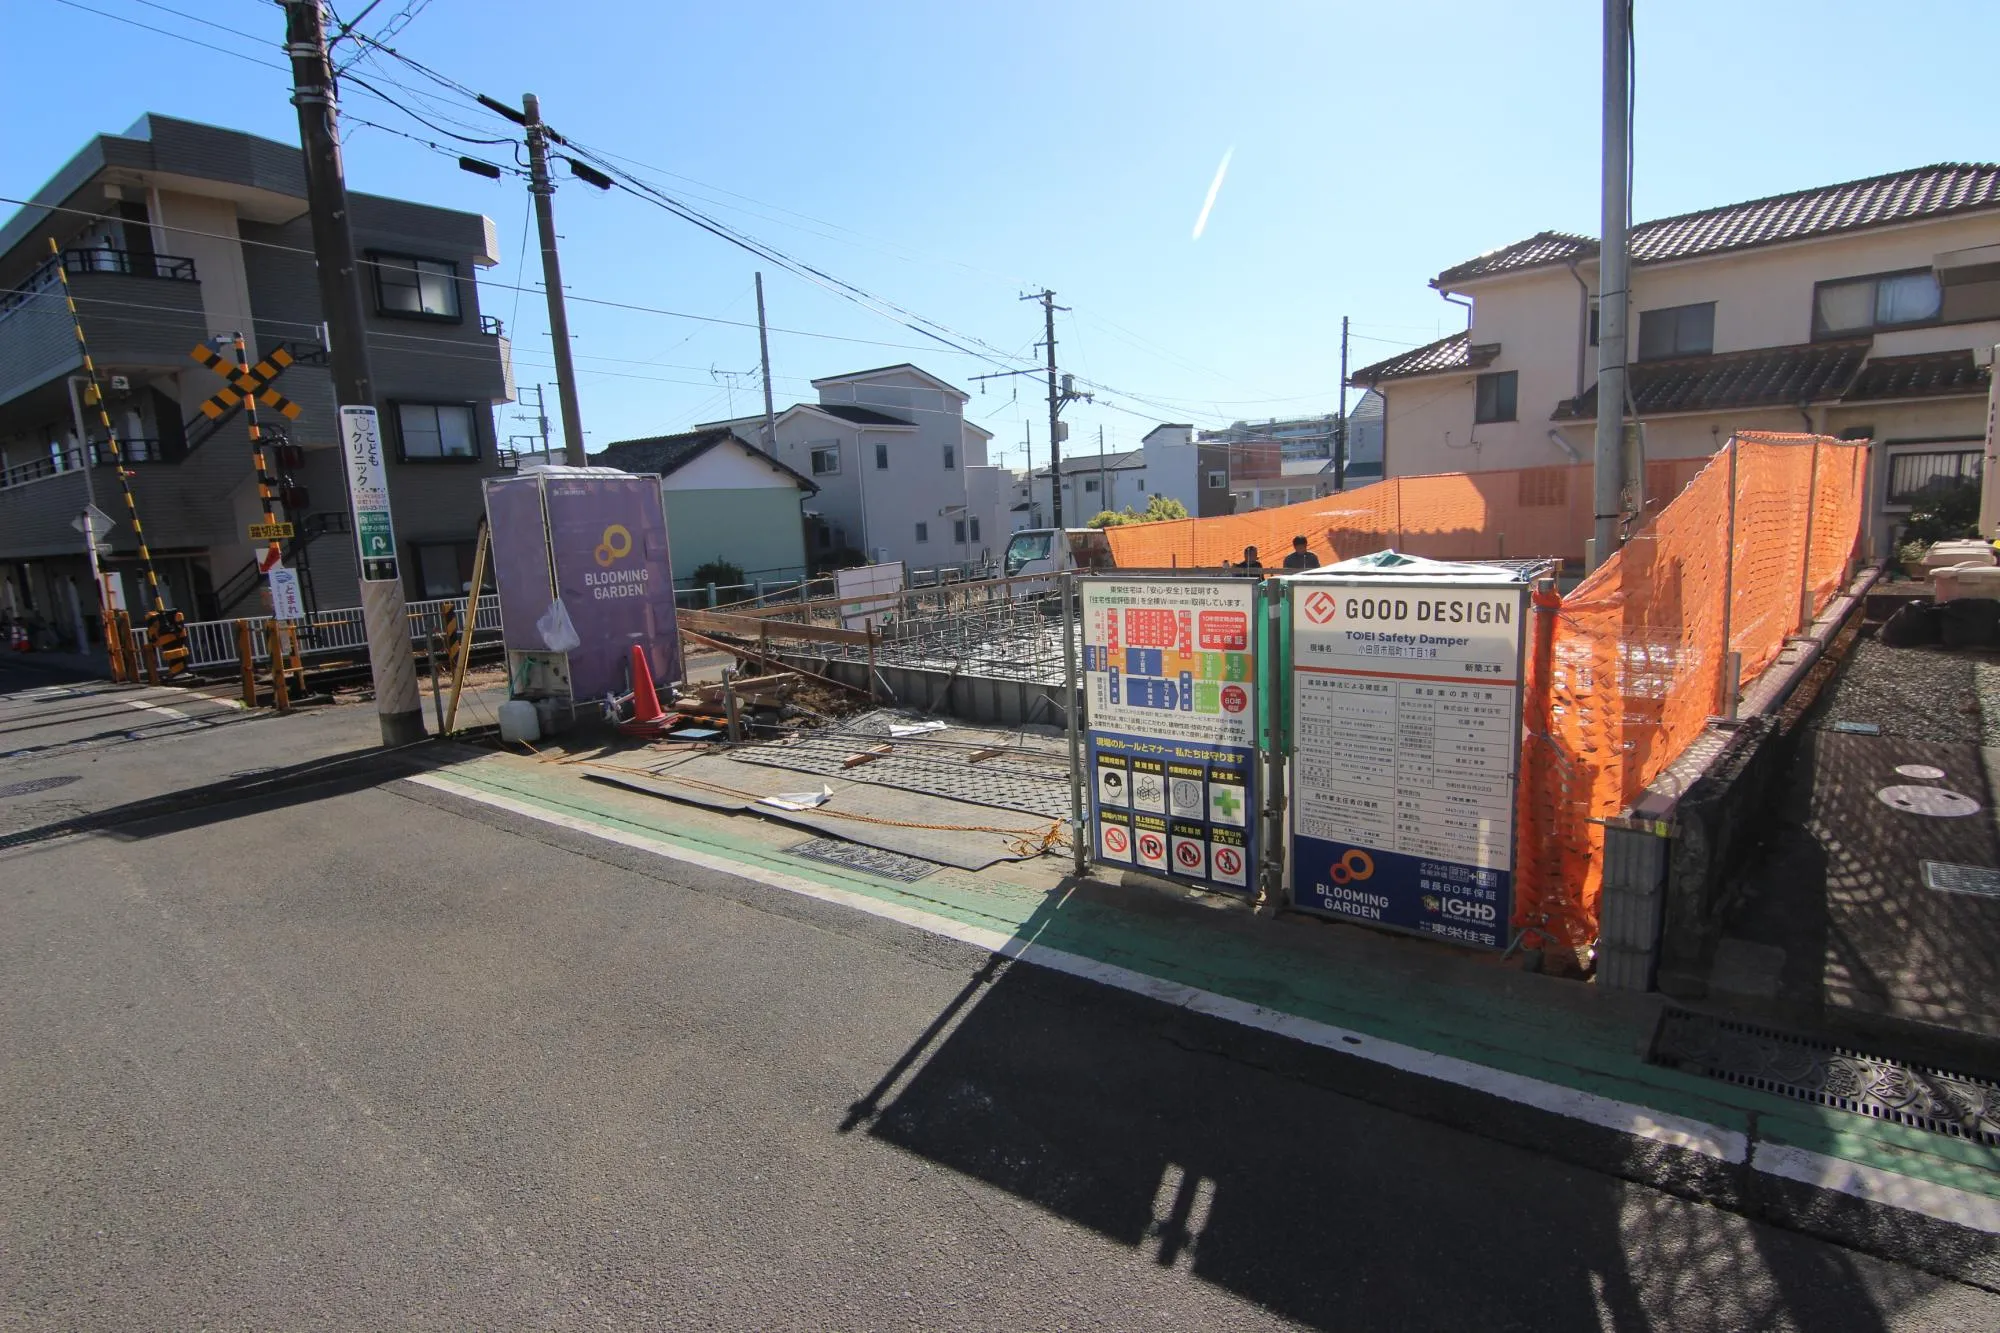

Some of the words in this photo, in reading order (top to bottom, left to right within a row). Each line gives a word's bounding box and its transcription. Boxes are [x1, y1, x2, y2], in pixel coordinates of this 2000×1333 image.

[367, 432, 379, 467] こども
[352, 432, 368, 486] クリニック
[250, 525, 293, 537] 踏切注意
[585, 569, 649, 586] BLOOMING
[593, 583, 644, 600] GARDEN
[1345, 598, 1408, 621] GOOD
[1417, 601, 1511, 624] DESIGN
[1202, 634, 1244, 645] 延長保証
[1378, 631, 1416, 645] Safety
[1419, 634, 1470, 647] Damper
[1309, 643, 1332, 653] 現場名
[1464, 663, 1502, 674] 新築工事
[1307, 679, 1388, 693] 建築基準法による確認済
[1415, 688, 1493, 701] 建設業の許可票
[1096, 737, 1173, 754] 現場のルールとマナー
[1176, 748, 1245, 764] 私たちは守ります
[1211, 771, 1240, 780] 安全第一
[1211, 835, 1242, 845] 立入禁止
[1212, 827, 1242, 838] 関係者以外
[1316, 883, 1389, 909] BLOOMING
[1420, 879, 1497, 901] 最長60年保証
[1324, 898, 1381, 920] GARDEN
[1442, 897, 1496, 921] IGHD
[1432, 923, 1496, 945] 東栄住宅
